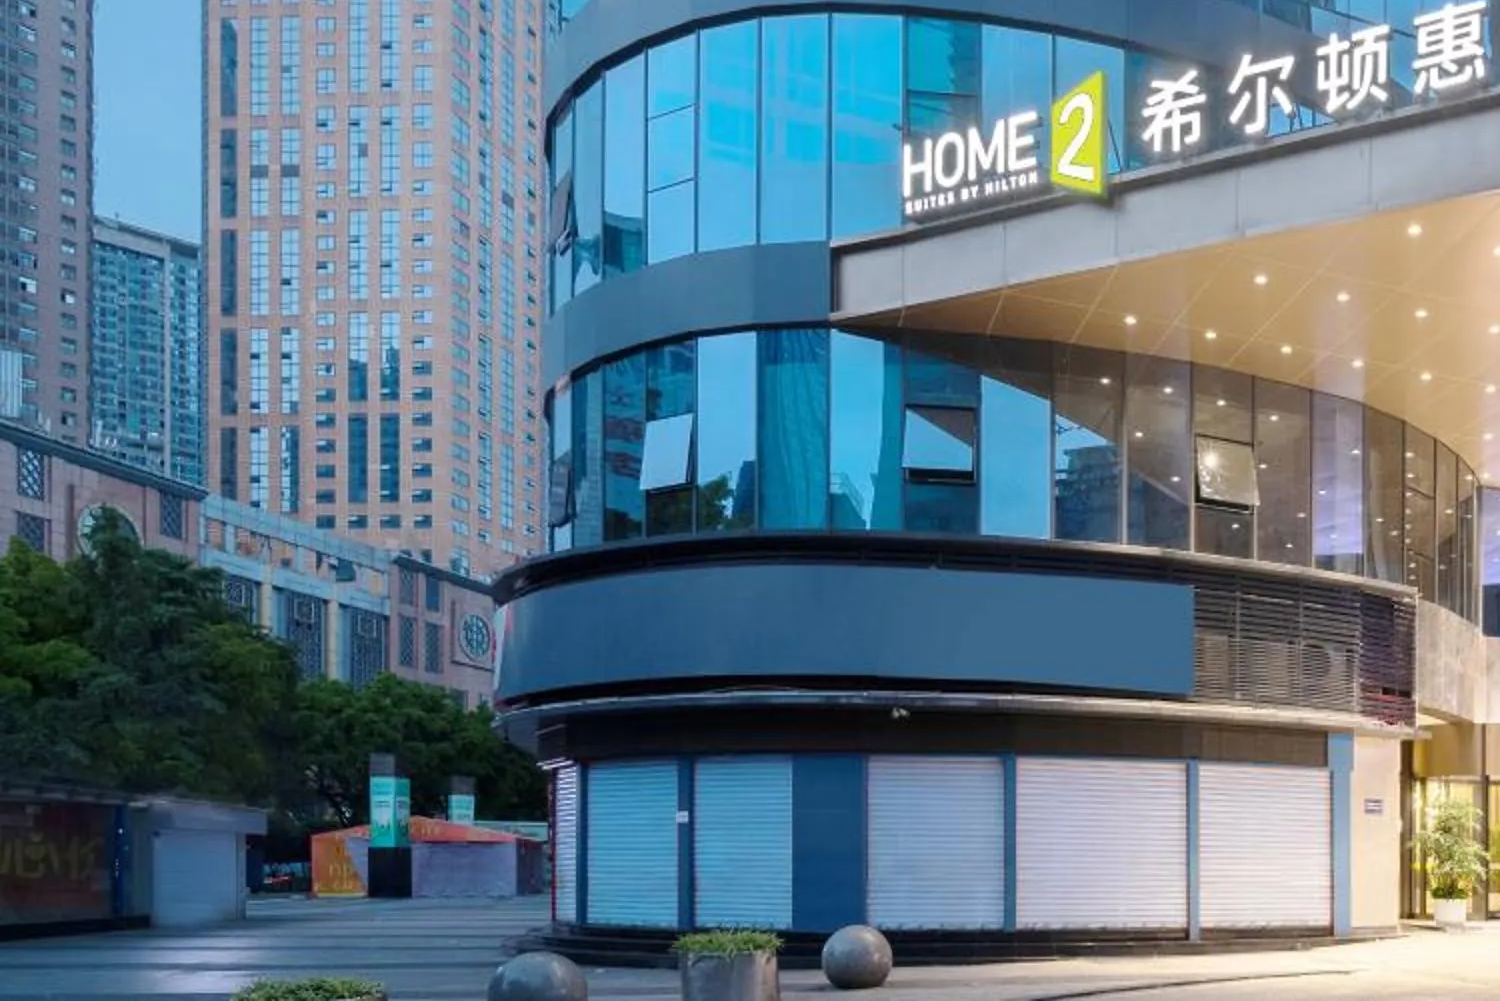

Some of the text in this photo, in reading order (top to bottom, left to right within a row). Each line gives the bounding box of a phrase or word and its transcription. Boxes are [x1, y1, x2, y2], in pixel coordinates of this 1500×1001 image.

[903, 93, 1095, 198] HOME 2
[984, 170, 1038, 196] HILTON
